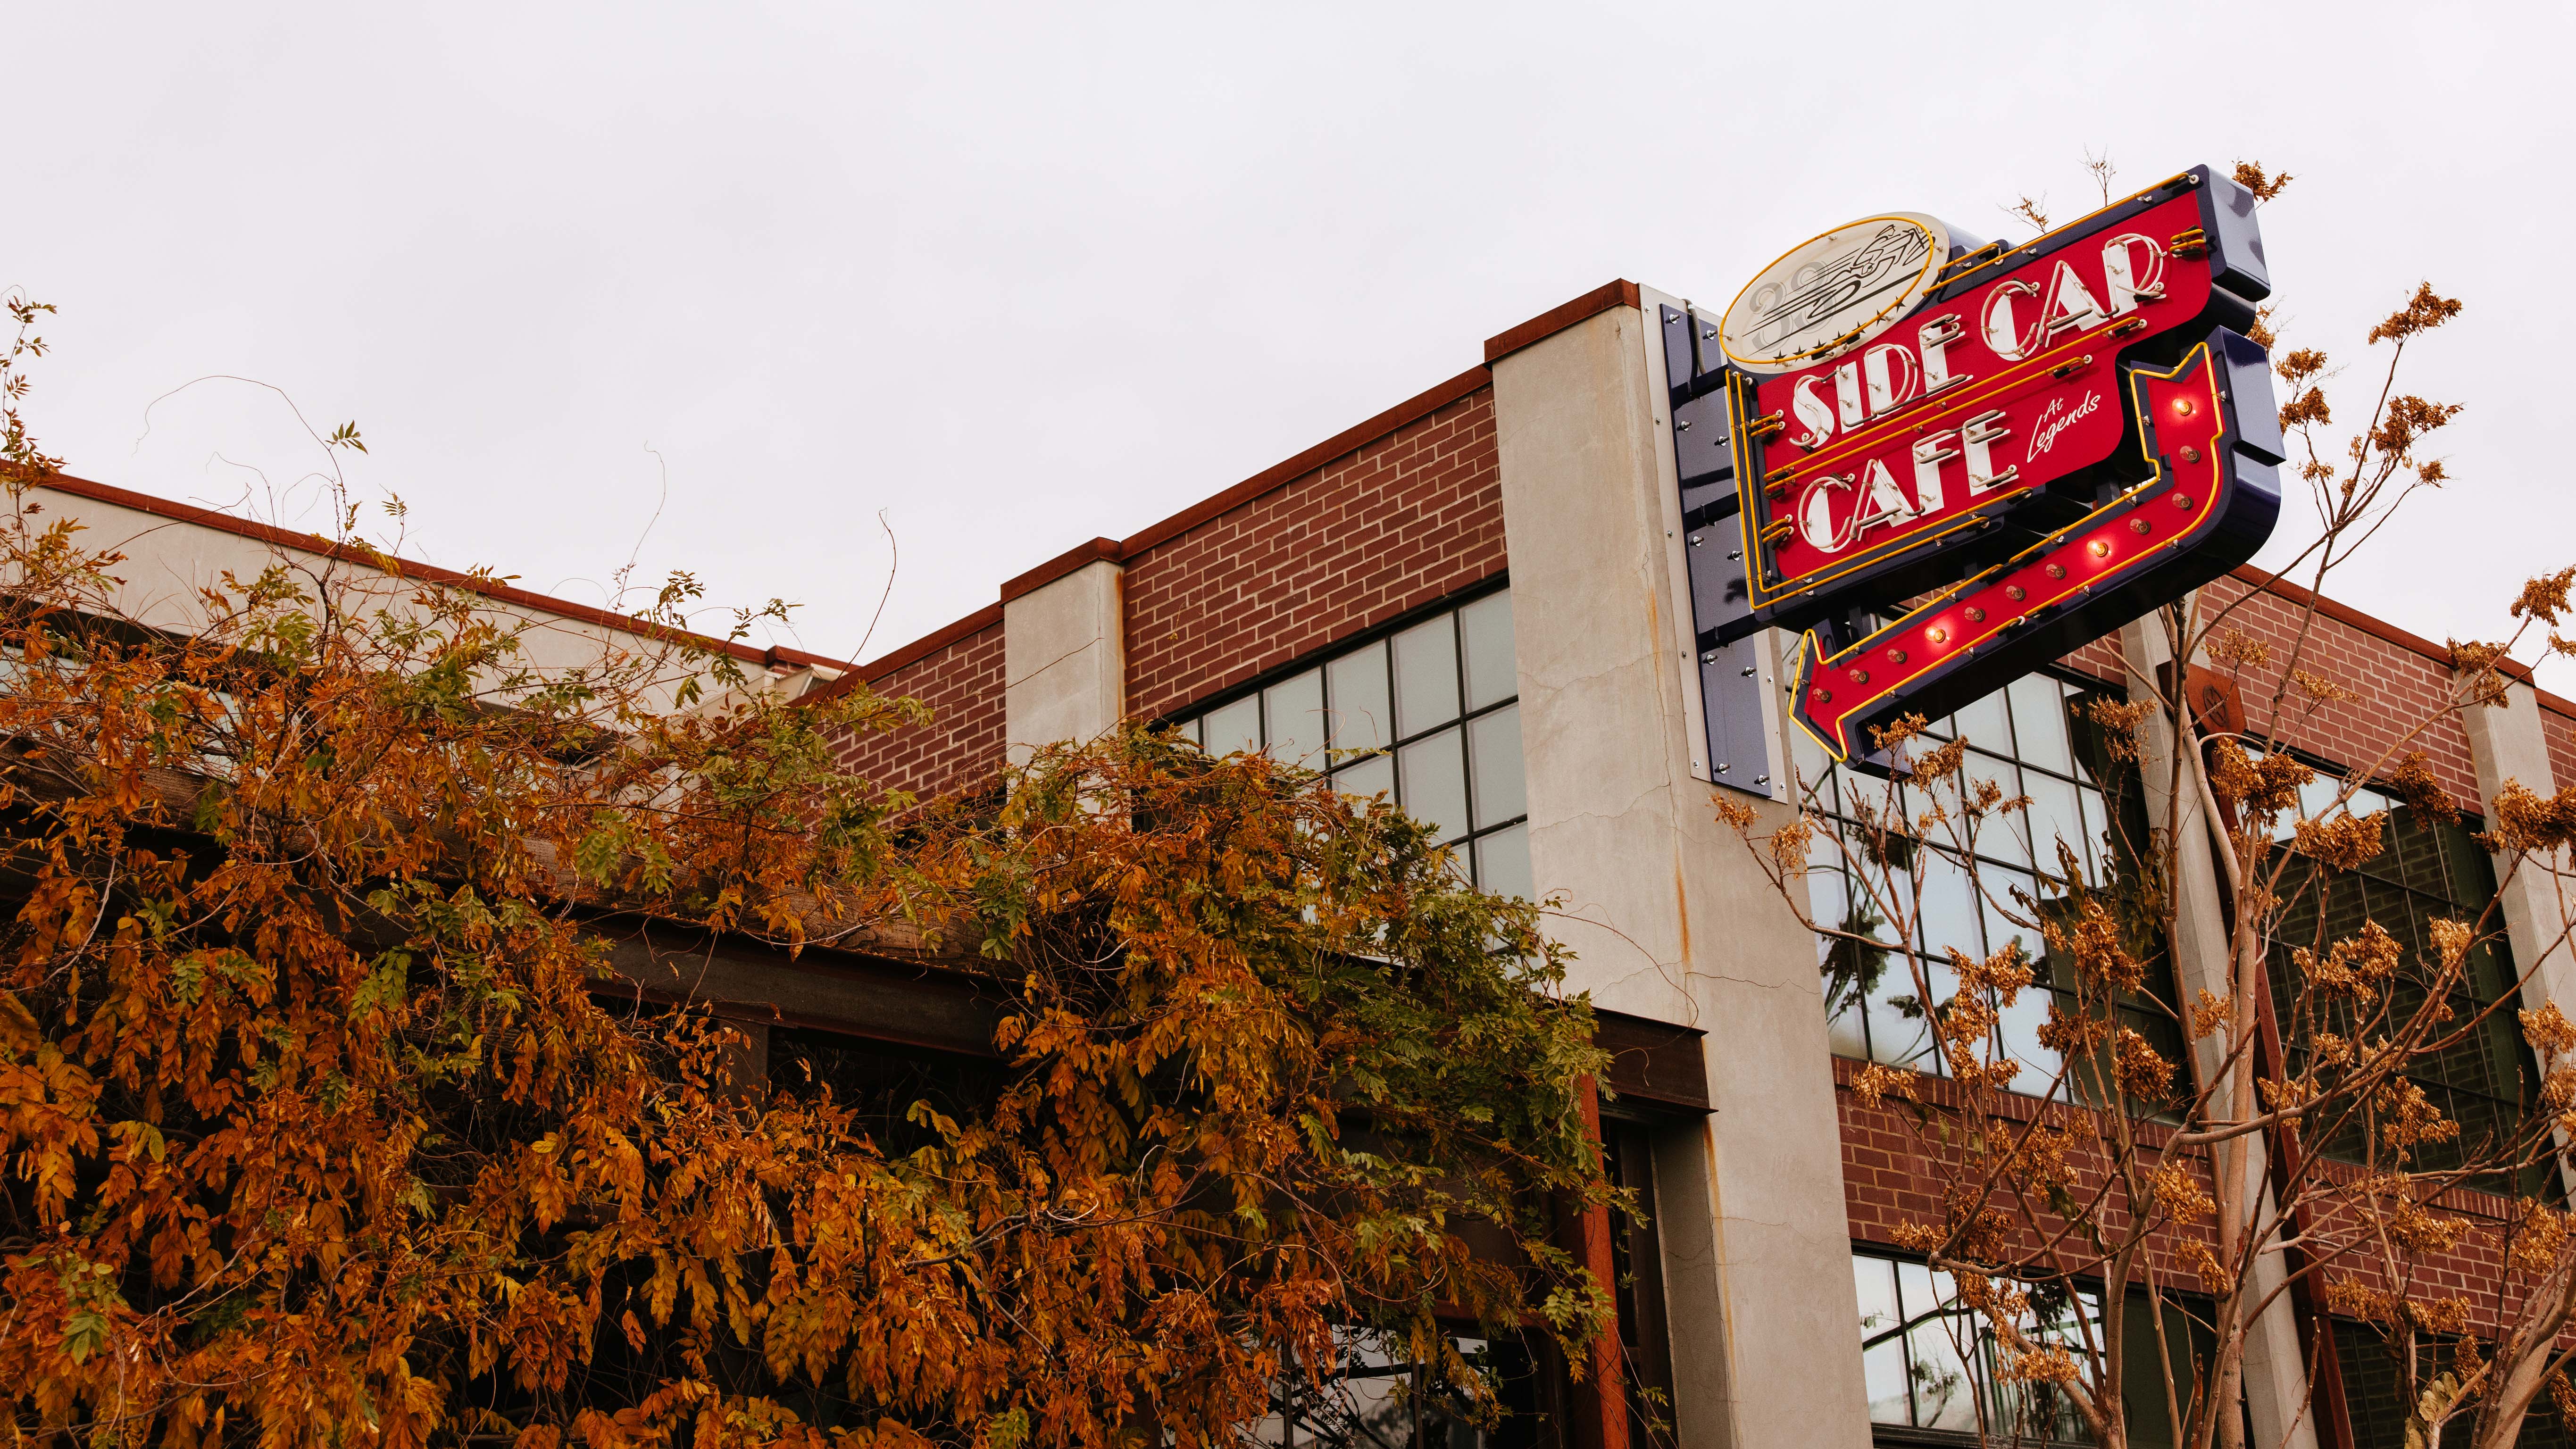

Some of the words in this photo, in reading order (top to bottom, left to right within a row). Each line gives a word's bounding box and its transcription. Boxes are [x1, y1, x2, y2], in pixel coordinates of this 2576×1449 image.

[1789, 313, 1974, 450] SIDE
[1981, 233, 2167, 361] CAR
[2027, 390, 2101, 463] Legends
[2043, 398, 2064, 422] At
[1798, 409, 2019, 553] CAFE
